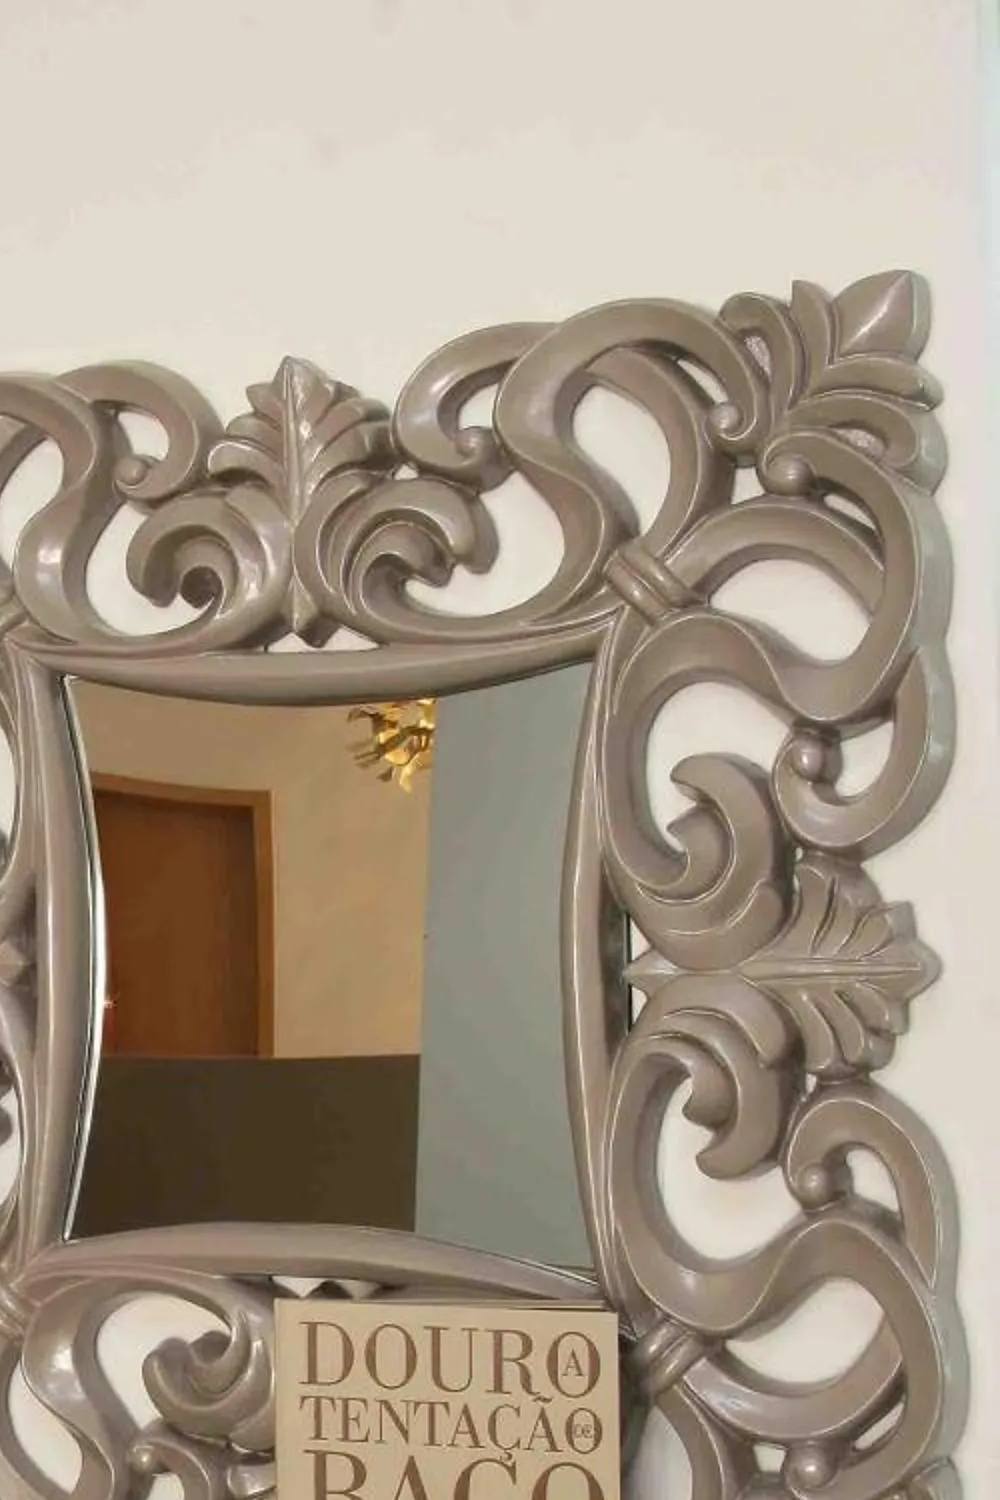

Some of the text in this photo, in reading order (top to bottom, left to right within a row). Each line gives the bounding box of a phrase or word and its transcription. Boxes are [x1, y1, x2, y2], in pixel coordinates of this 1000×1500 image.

[298, 1321, 600, 1398] DOURO A
[299, 1395, 603, 1462] TENTAÇÃO
